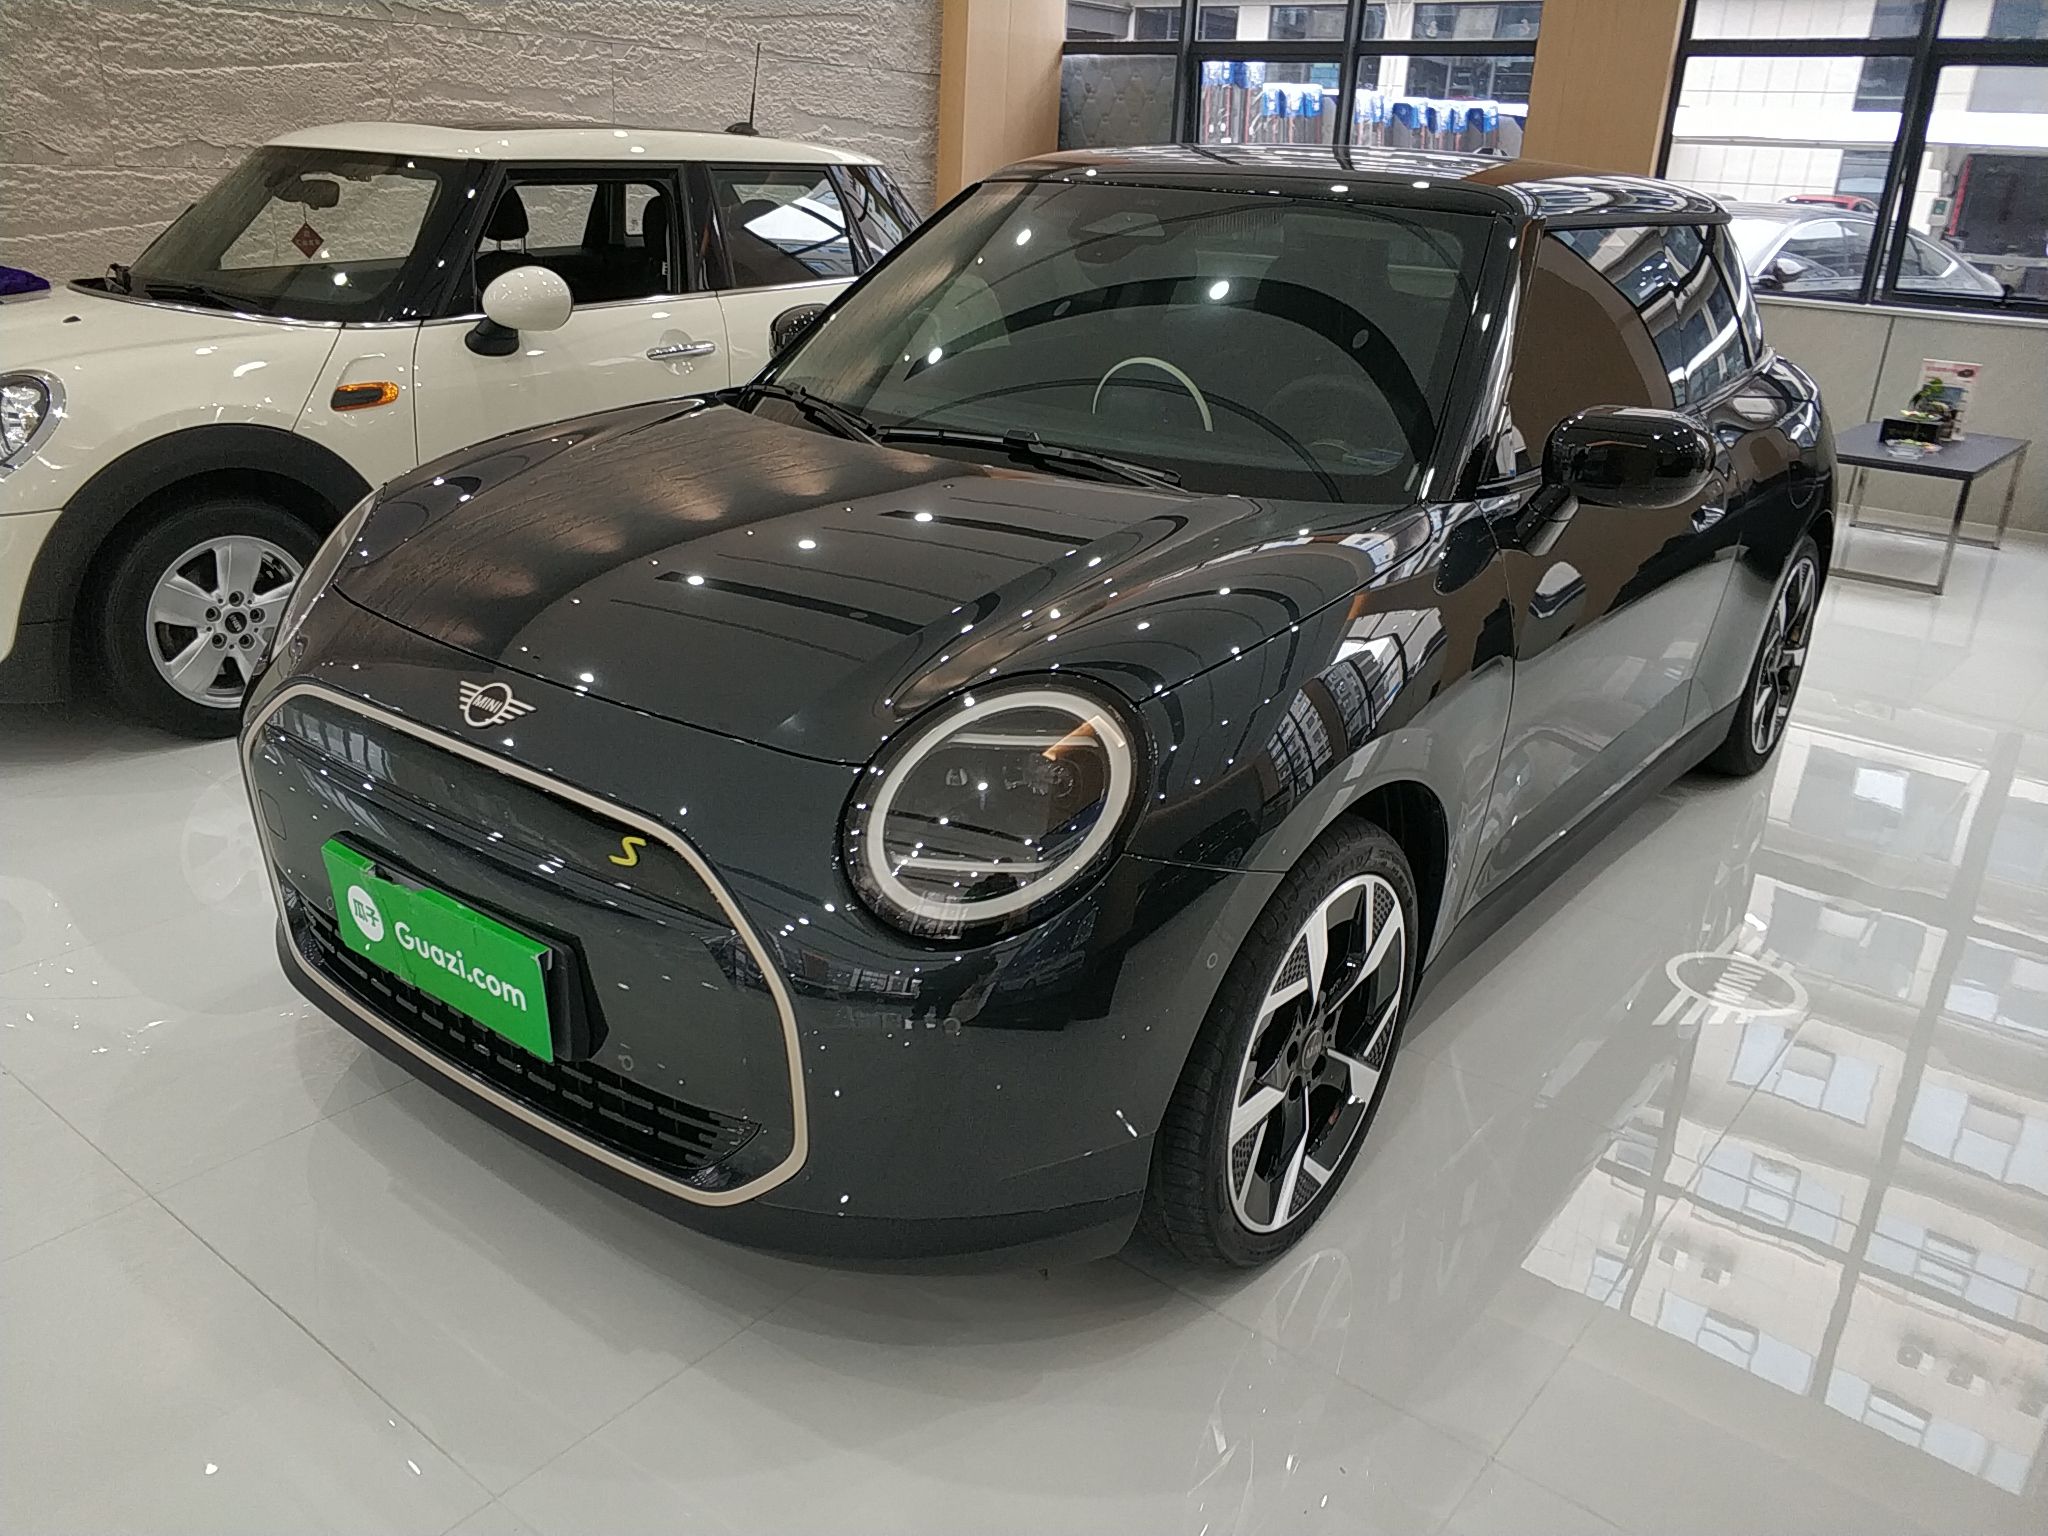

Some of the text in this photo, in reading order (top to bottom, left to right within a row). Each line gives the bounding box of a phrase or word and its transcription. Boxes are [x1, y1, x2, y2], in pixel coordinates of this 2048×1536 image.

[472, 694, 503, 714] MINI
[608, 836, 647, 866] S
[352, 898, 528, 1012] 瓜子 Guazi.com
[1706, 960, 1767, 1005] MINI
